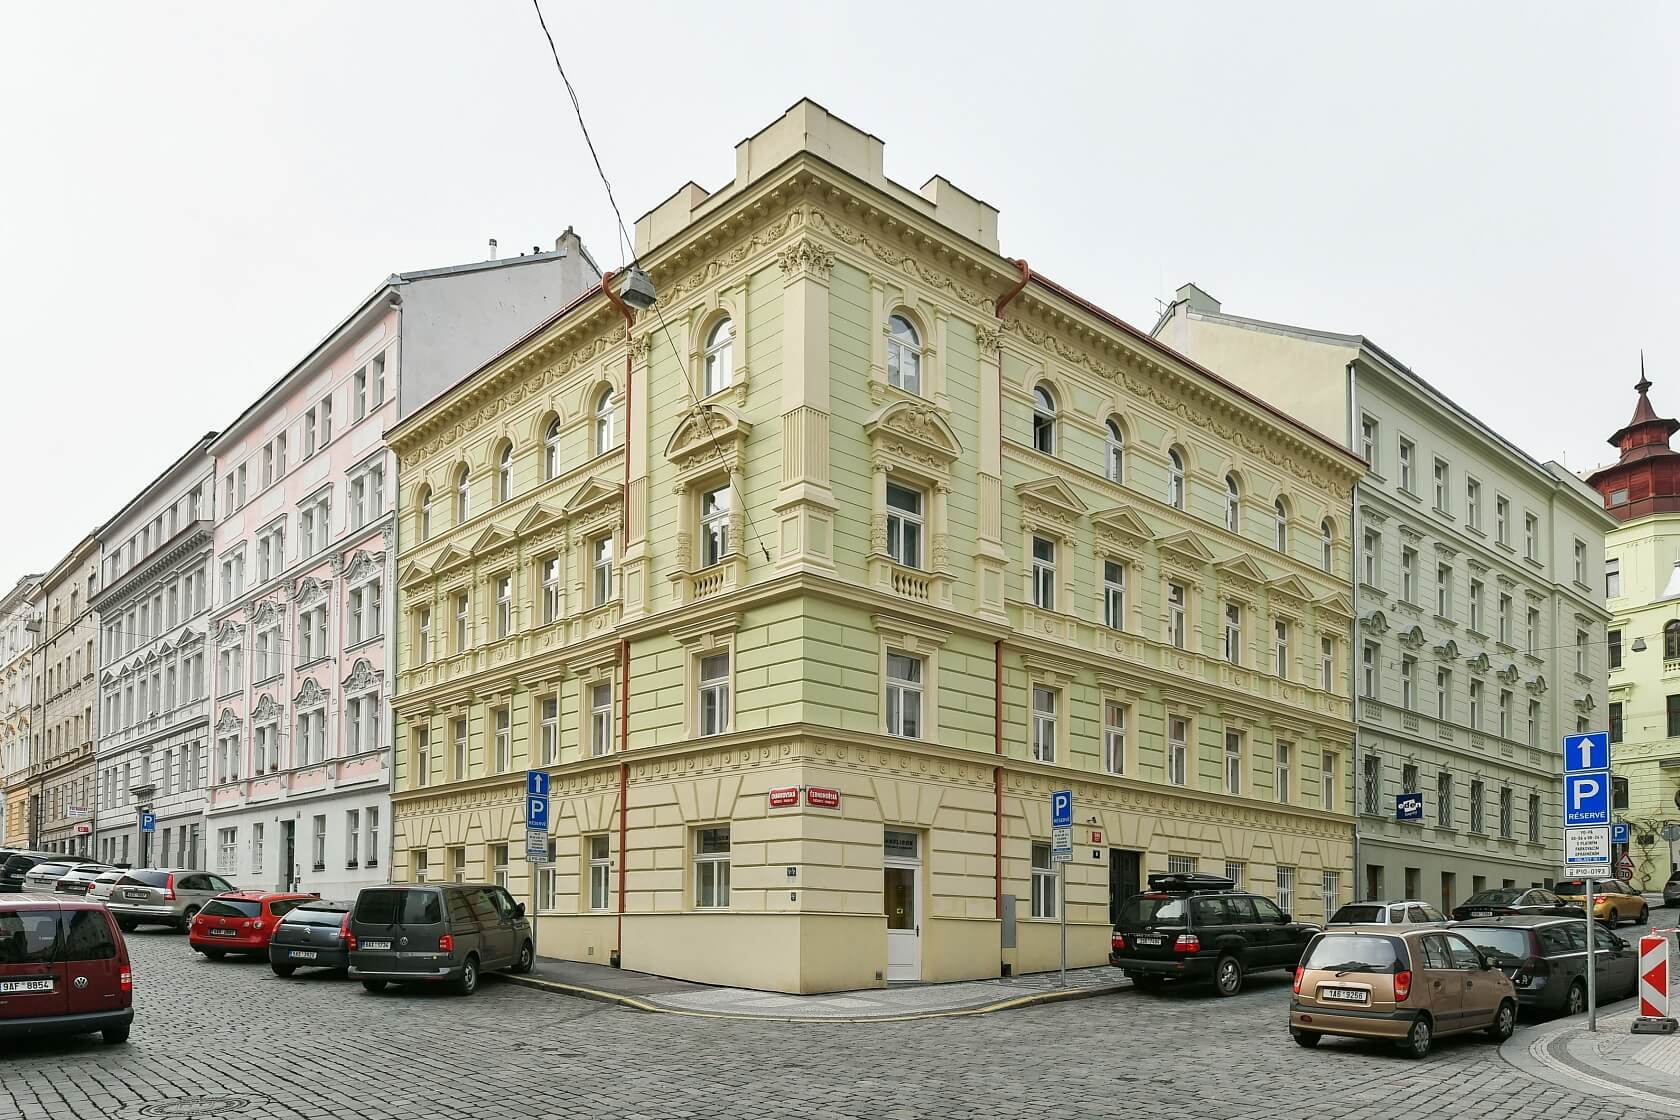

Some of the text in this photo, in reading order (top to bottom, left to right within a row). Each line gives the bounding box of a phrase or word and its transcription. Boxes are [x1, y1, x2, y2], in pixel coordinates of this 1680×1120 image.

[1573, 779, 1600, 810] P
[531, 799, 544, 819] P
[1056, 795, 1067, 817] P
[144, 816, 152, 827] P
[1568, 811, 1606, 821] RÉSERVÉ
[1614, 826, 1625, 838] P
[3, 981, 49, 991] 9AF 8854
